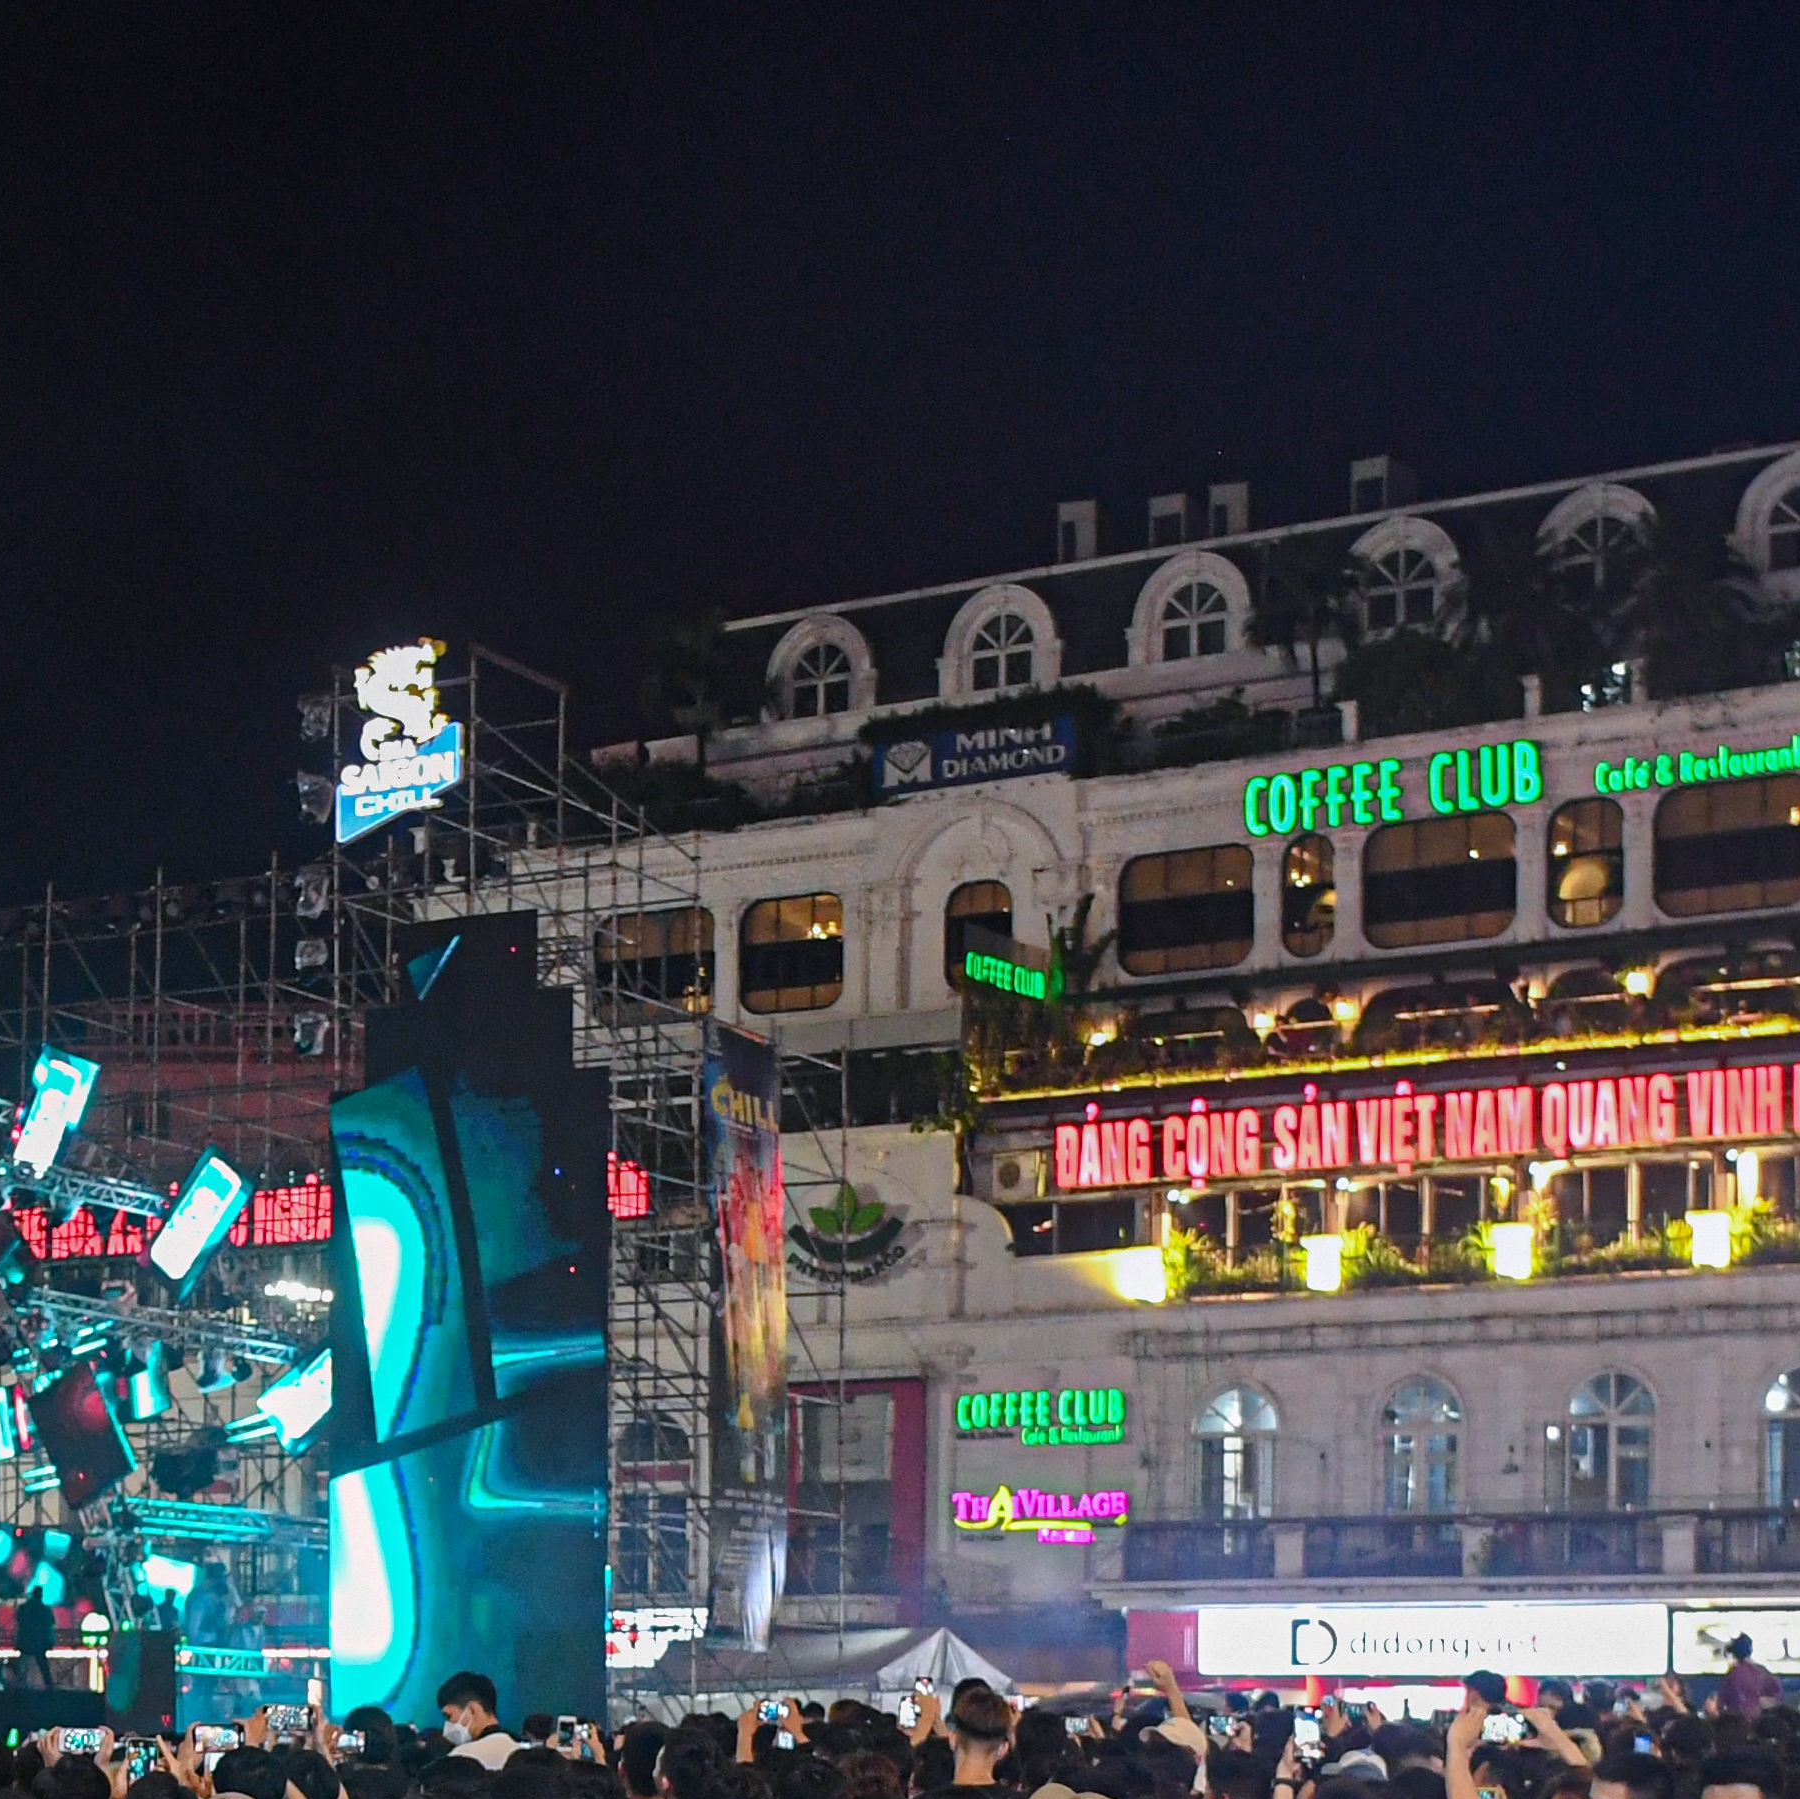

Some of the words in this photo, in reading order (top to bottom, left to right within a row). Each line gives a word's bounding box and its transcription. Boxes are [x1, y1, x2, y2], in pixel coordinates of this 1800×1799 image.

[955, 722, 1052, 754] MINH
[340, 750, 456, 797] SAIGON
[942, 744, 1066, 779] DIAMOND
[354, 787, 441, 818] CHILL
[1243, 757, 1405, 838] COFFEE
[1427, 738, 1544, 816] CLUB
[1655, 753, 1674, 788] &
[1054, 1101, 1153, 1190] ĐẢNG
[1161, 1096, 1262, 1190] CỘNG
[1271, 1082, 1350, 1172] SẢN
[1355, 1078, 1439, 1178] VIỆT
[1444, 1085, 1536, 1160] NAM
[1540, 1072, 1677, 1159] QUANG
[1686, 1064, 1785, 1139] VINH
[955, 1388, 1052, 1431] COFFEE
[1057, 1387, 1127, 1427] CLUB
[1349, 1631, 1539, 1660] didongviet
